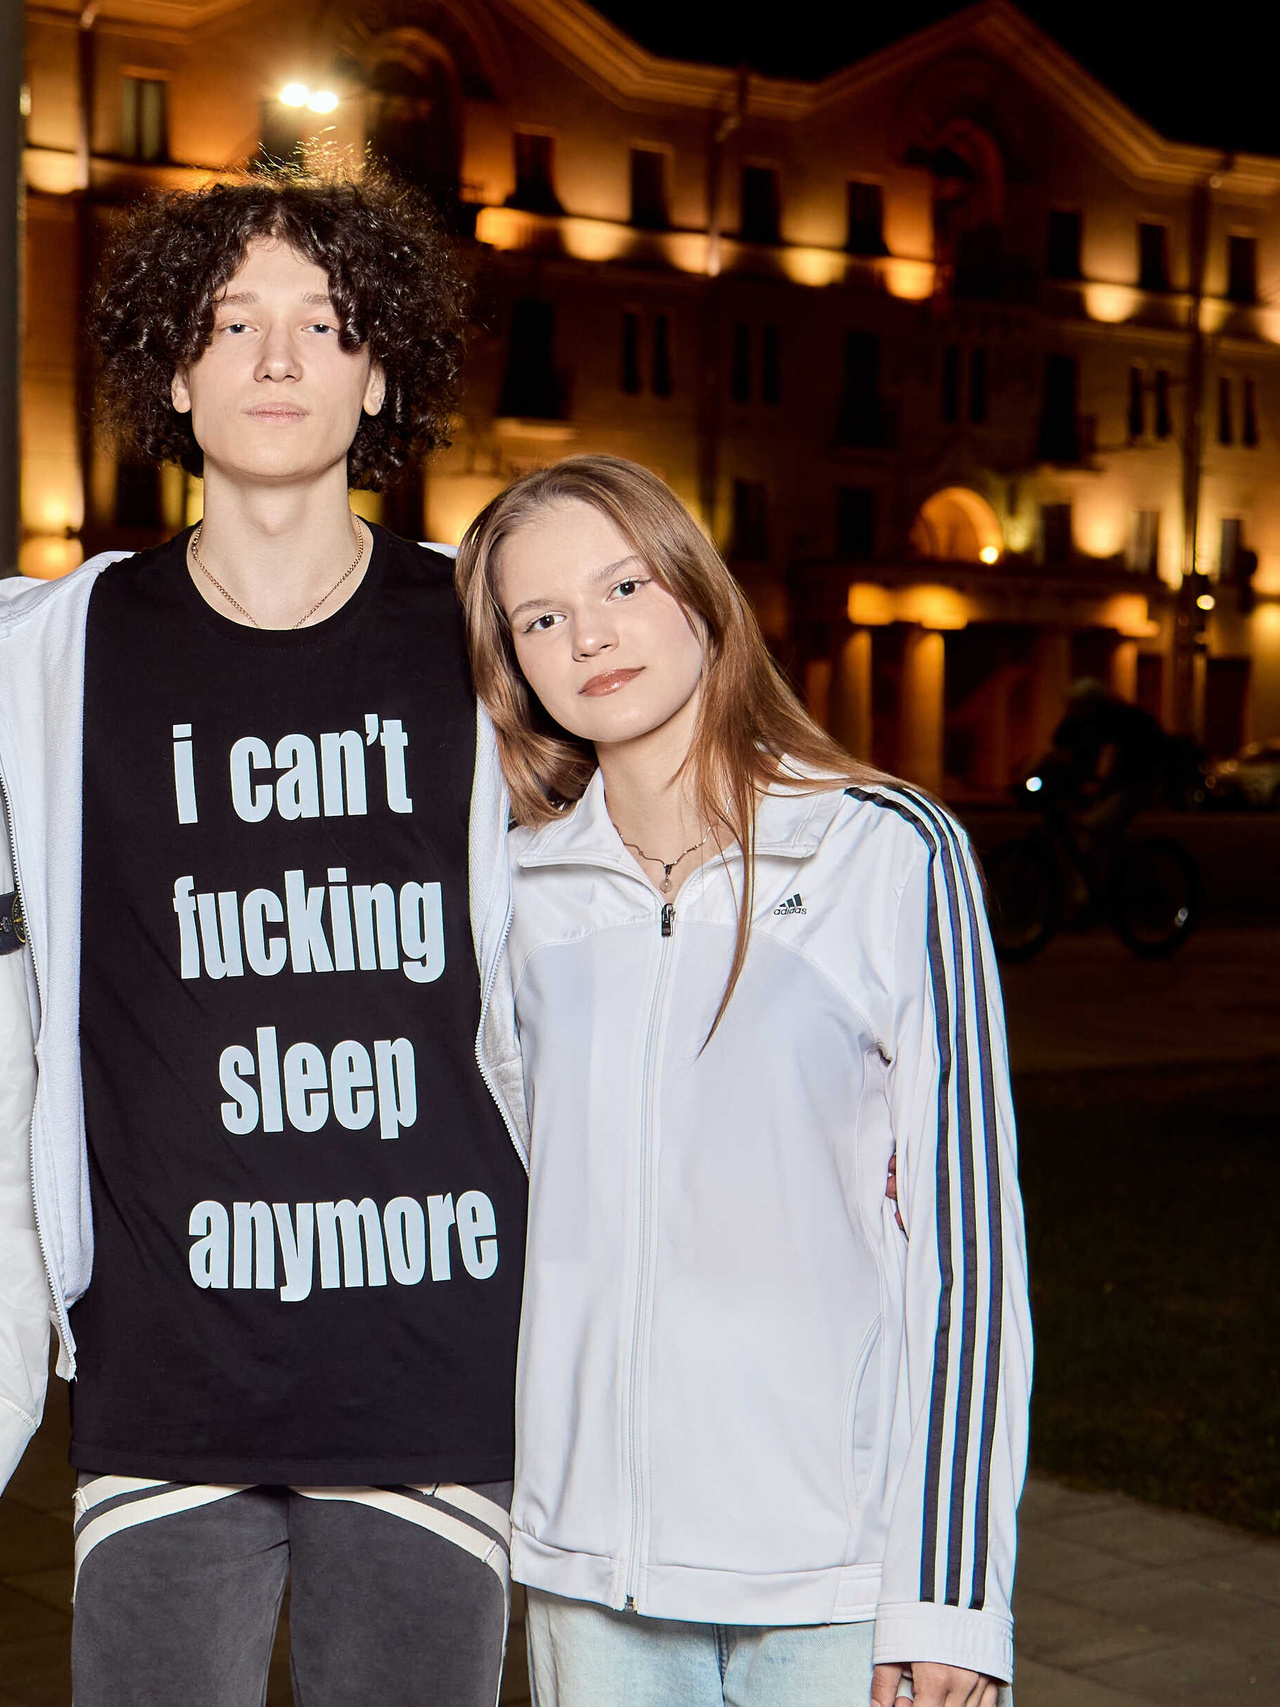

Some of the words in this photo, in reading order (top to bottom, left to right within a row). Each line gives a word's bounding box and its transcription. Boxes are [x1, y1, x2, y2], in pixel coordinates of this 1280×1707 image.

[172, 723, 199, 824] i
[229, 713, 413, 823] can't
[172, 867, 446, 984] fucking
[773, 905, 808, 916] adidas
[218, 1025, 418, 1140] sleep
[188, 1190, 499, 1302] anymore
